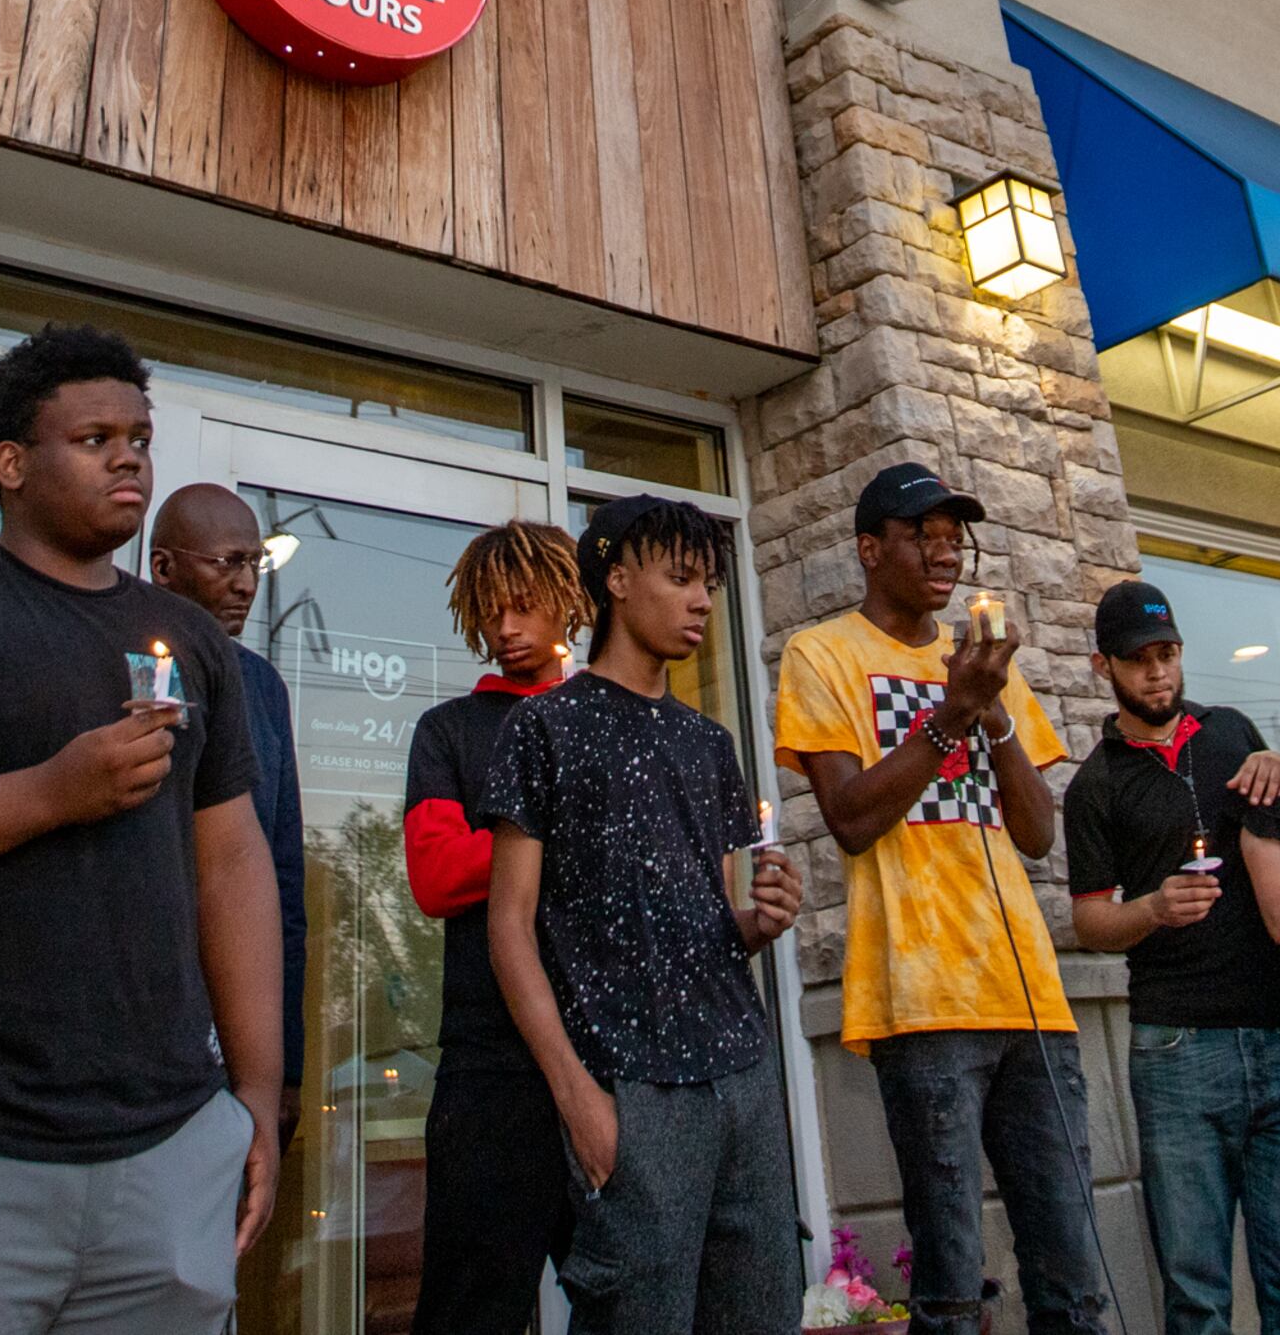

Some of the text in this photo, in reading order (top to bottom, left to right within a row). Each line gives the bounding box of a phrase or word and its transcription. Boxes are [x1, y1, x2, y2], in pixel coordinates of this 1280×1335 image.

[330, 647, 407, 689] IHOP
[310, 754, 352, 768] PLEASE
[354, 758, 371, 770] NO
